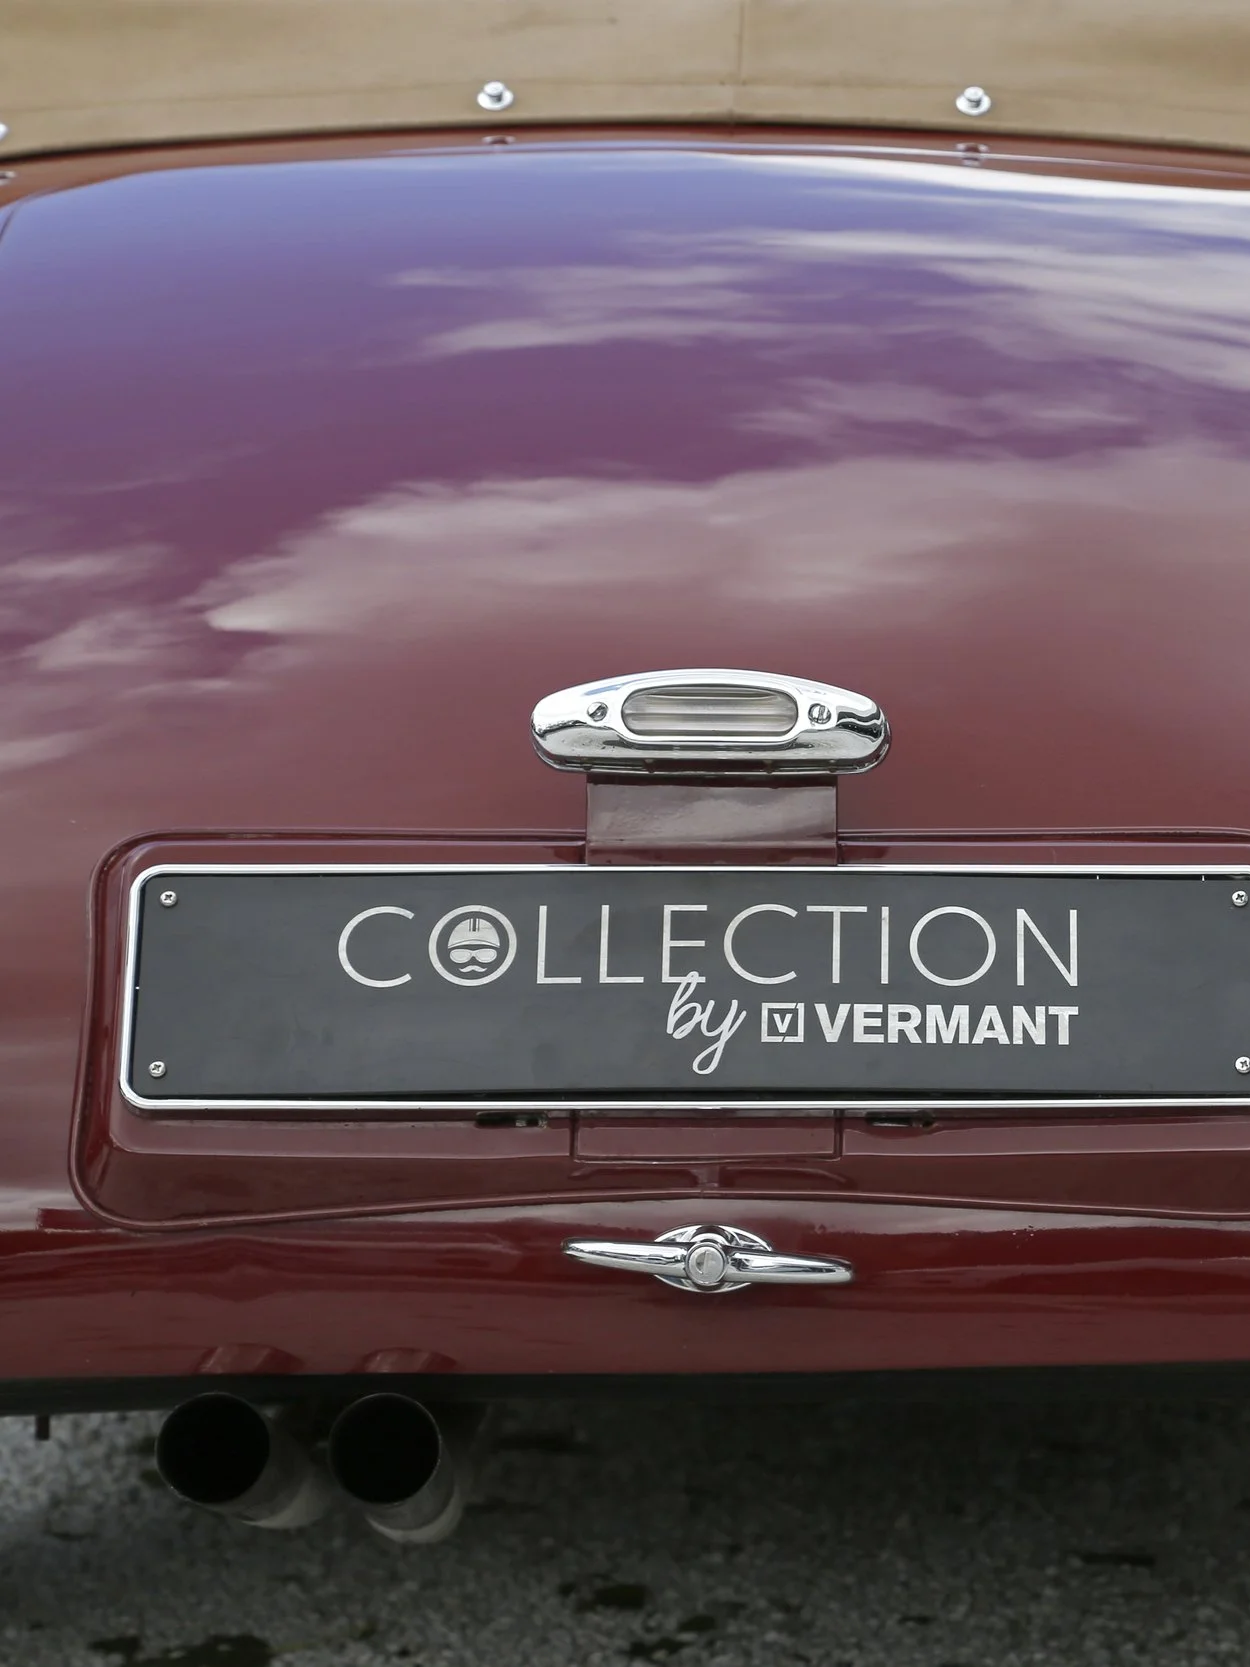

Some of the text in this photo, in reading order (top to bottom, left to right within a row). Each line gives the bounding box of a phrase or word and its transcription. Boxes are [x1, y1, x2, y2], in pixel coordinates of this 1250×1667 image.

[338, 904, 1079, 987] COLLECTION
[666, 970, 747, 1075] by
[814, 1003, 1079, 1045] VERMANT
